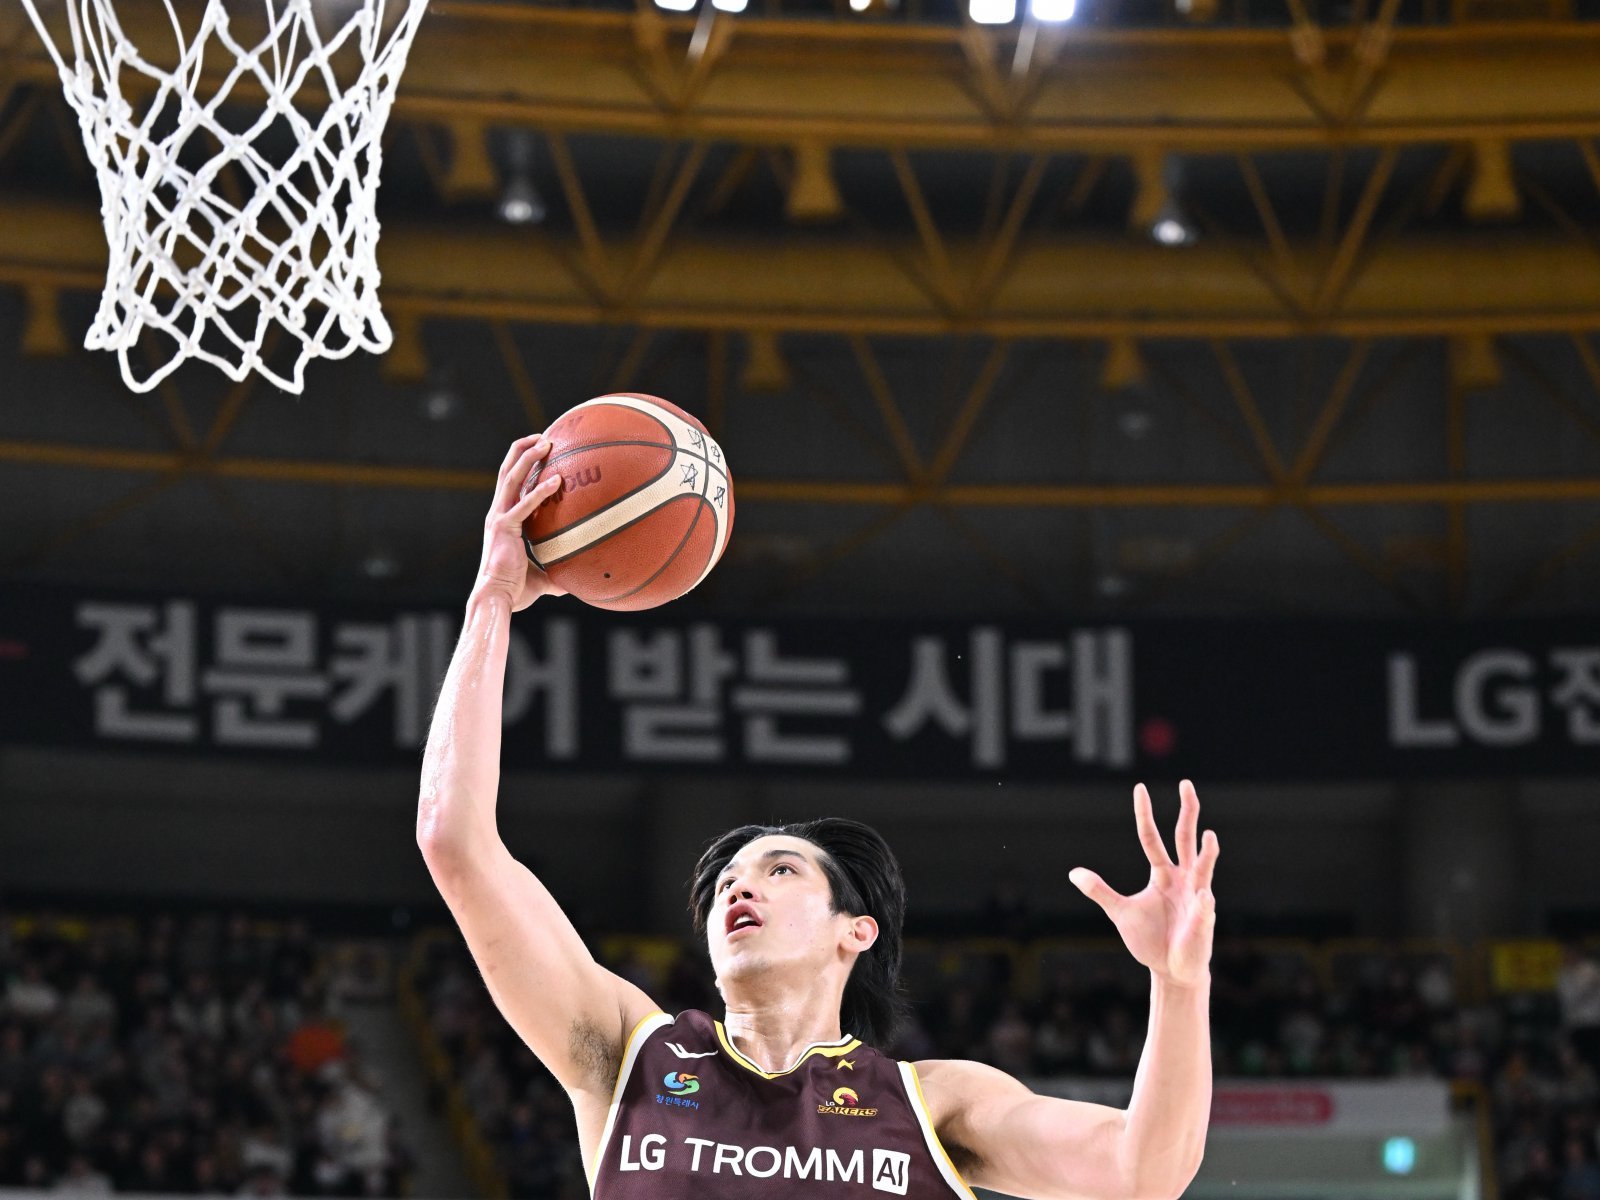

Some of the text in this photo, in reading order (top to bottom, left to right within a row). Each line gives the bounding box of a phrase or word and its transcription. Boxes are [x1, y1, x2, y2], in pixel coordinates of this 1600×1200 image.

[606, 621, 861, 765] 받는
[619, 1133, 666, 1172] LG
[684, 1137, 865, 1184] TROMM
